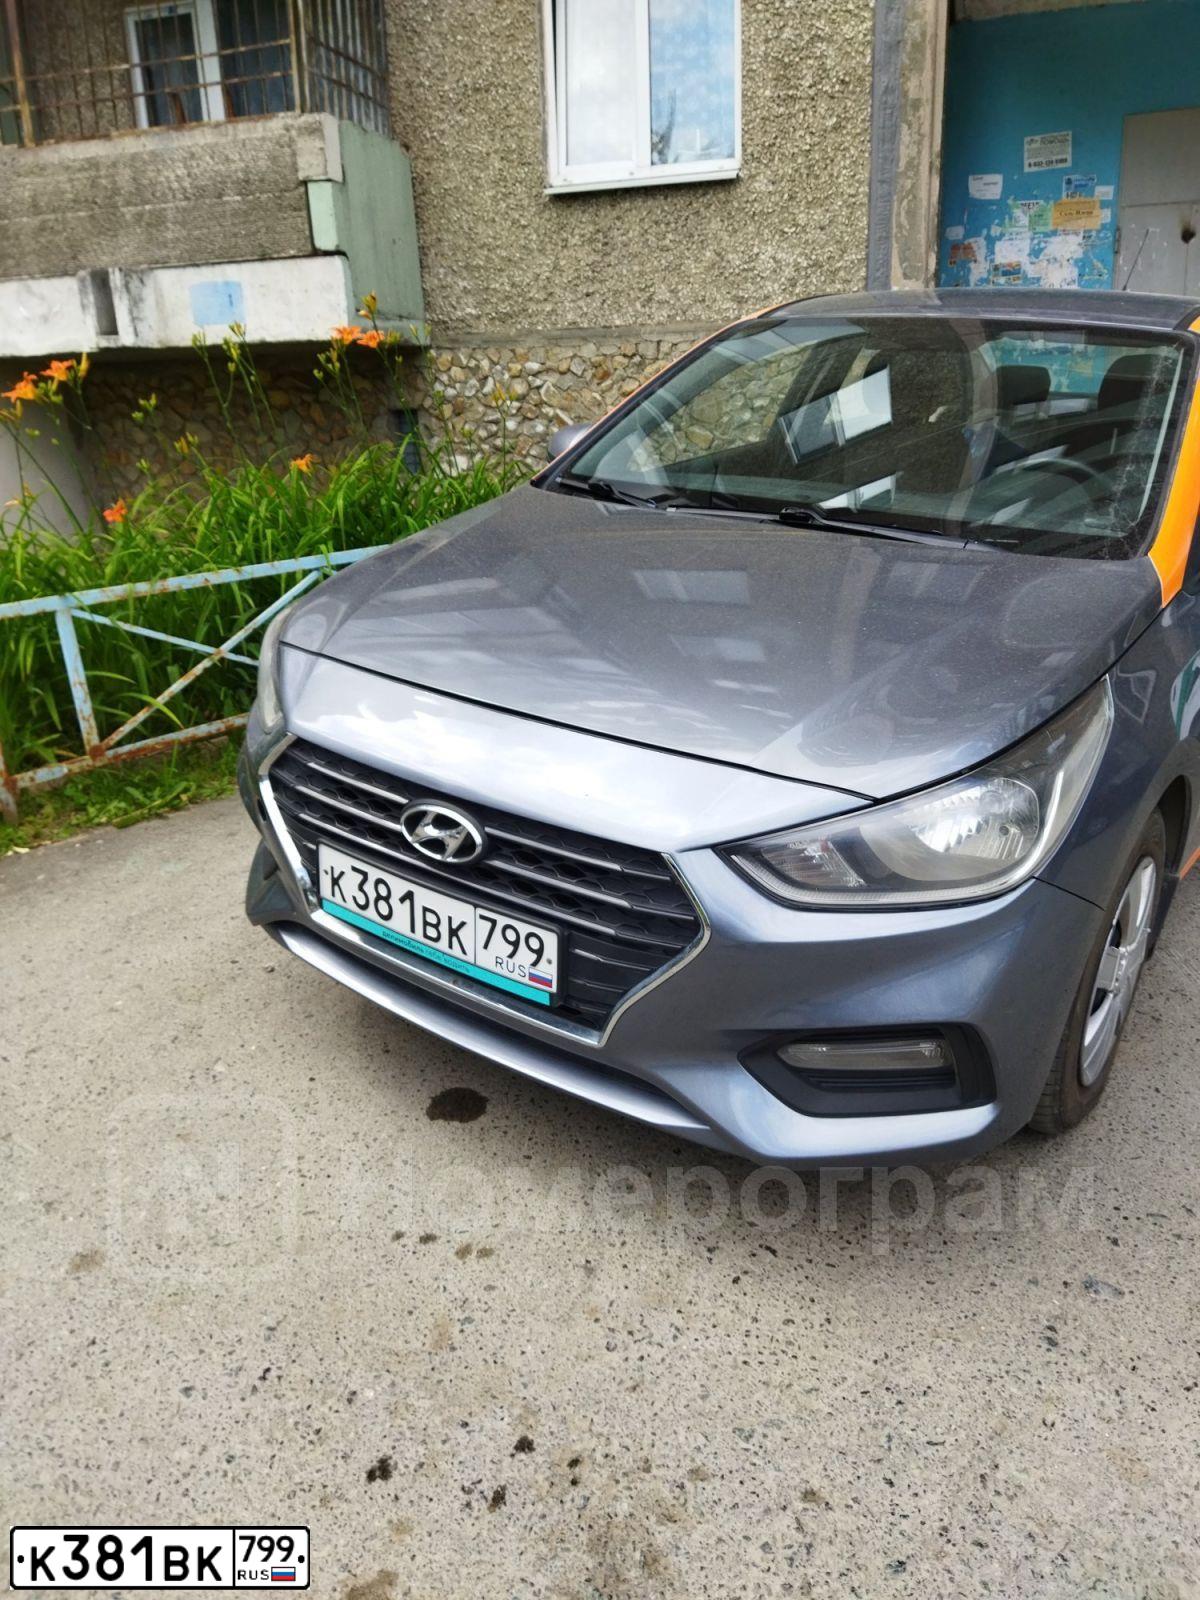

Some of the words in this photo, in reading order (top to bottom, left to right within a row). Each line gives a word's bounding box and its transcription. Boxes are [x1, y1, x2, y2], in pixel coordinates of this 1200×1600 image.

[331, 865, 467, 956] К381ВК
[479, 914, 544, 967] 799
[495, 956, 526, 978] RUS
